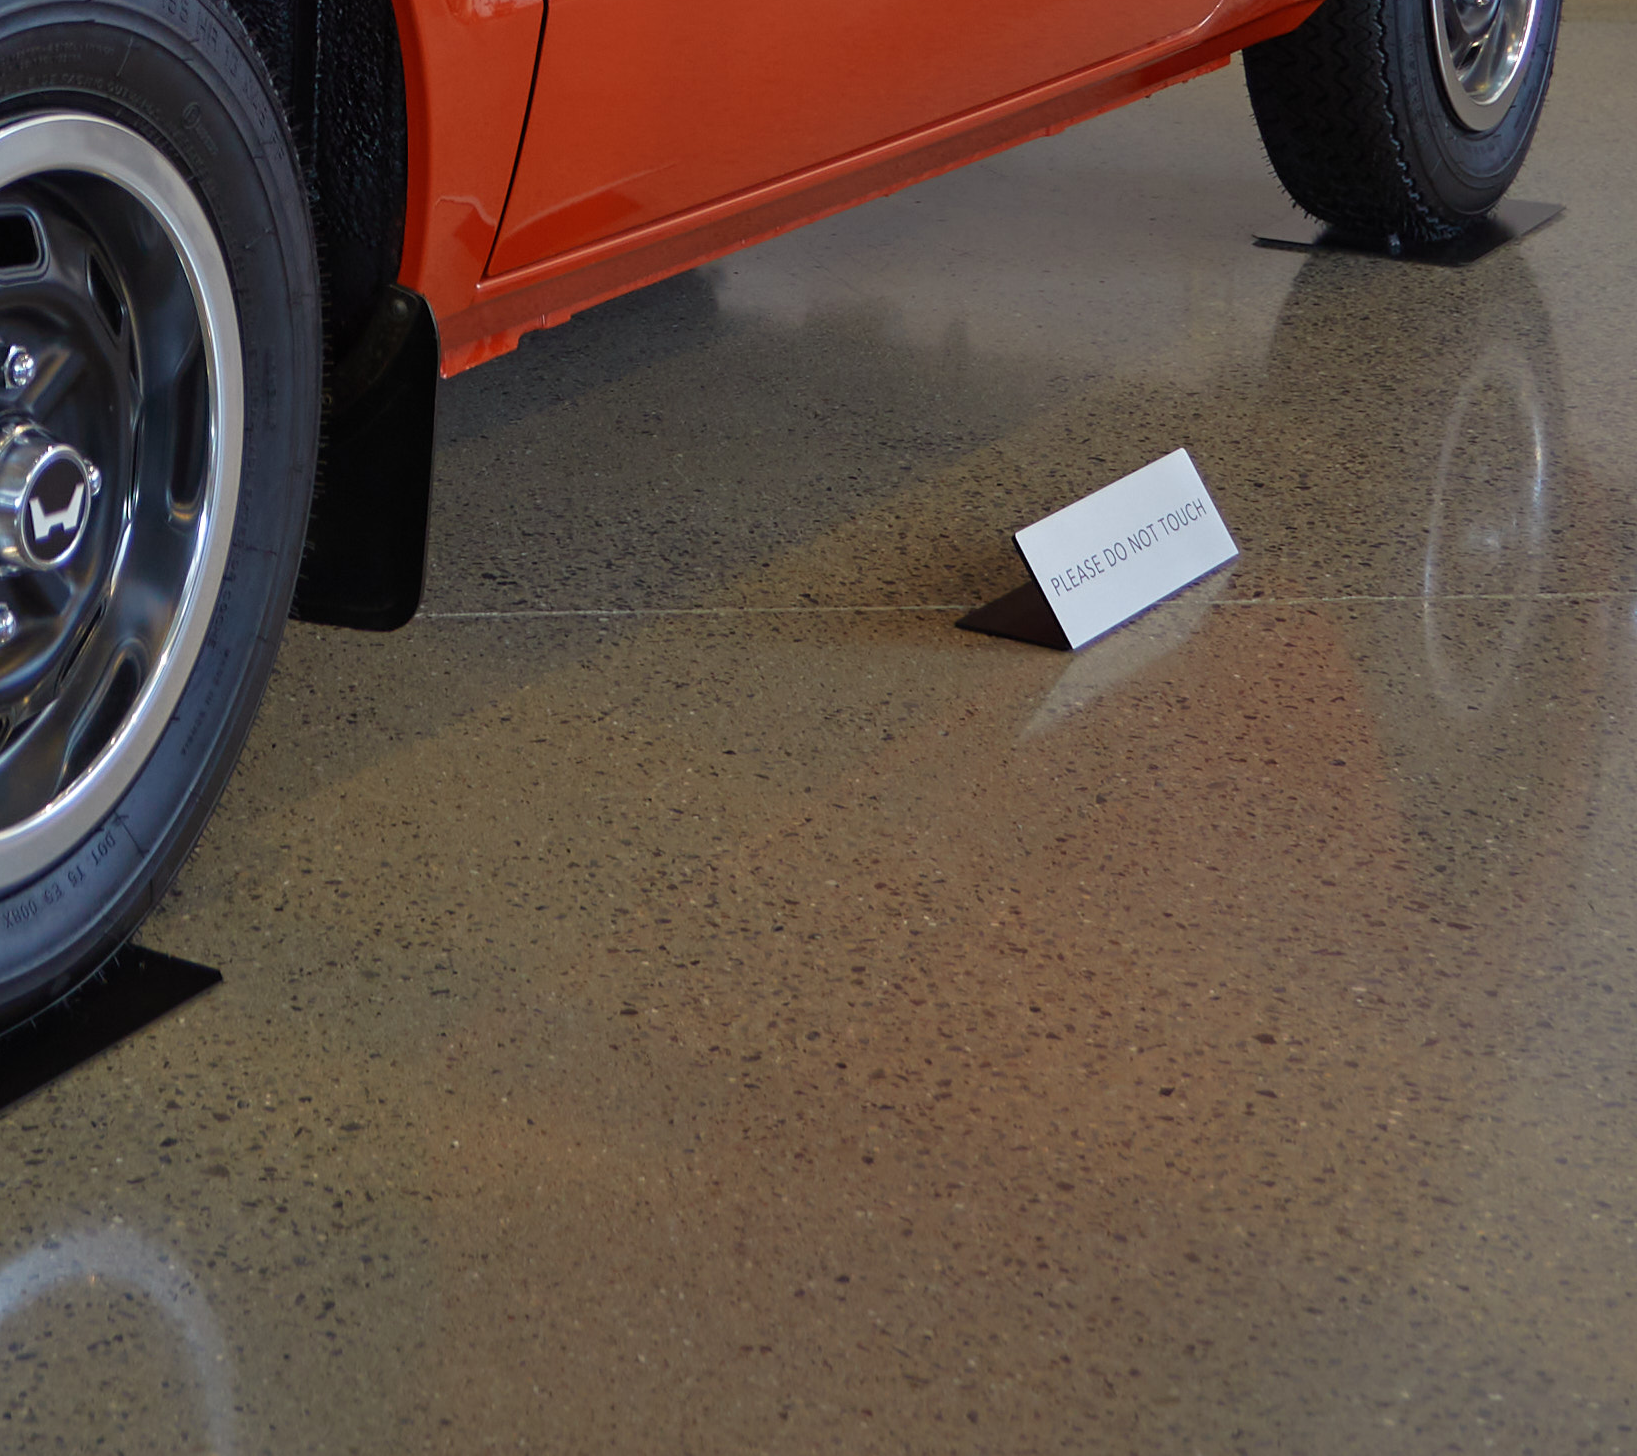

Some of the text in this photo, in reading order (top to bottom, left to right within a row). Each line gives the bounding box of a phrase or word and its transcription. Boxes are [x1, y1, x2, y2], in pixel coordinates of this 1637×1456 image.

[1050, 498, 1207, 597] PLEASE DO NOT TOUCH
